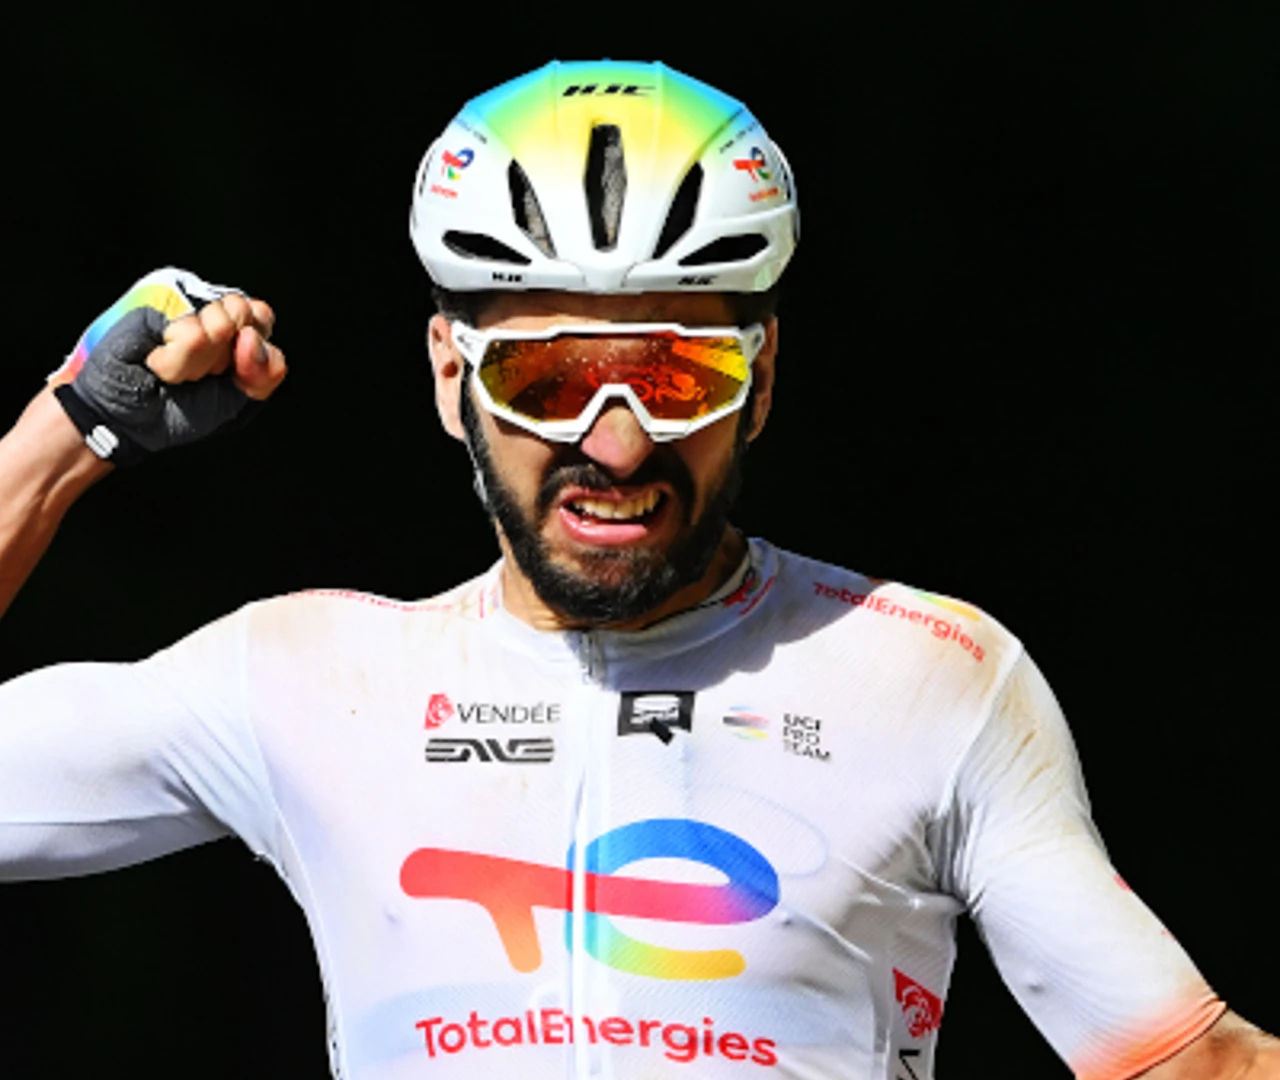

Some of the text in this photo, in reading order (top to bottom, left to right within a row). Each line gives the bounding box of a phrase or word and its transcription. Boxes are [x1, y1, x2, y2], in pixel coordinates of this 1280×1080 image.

[812, 581, 987, 664] TotalEnergies
[457, 701, 561, 724] VENDÉE
[416, 1009, 778, 1066] TotalEnergies
